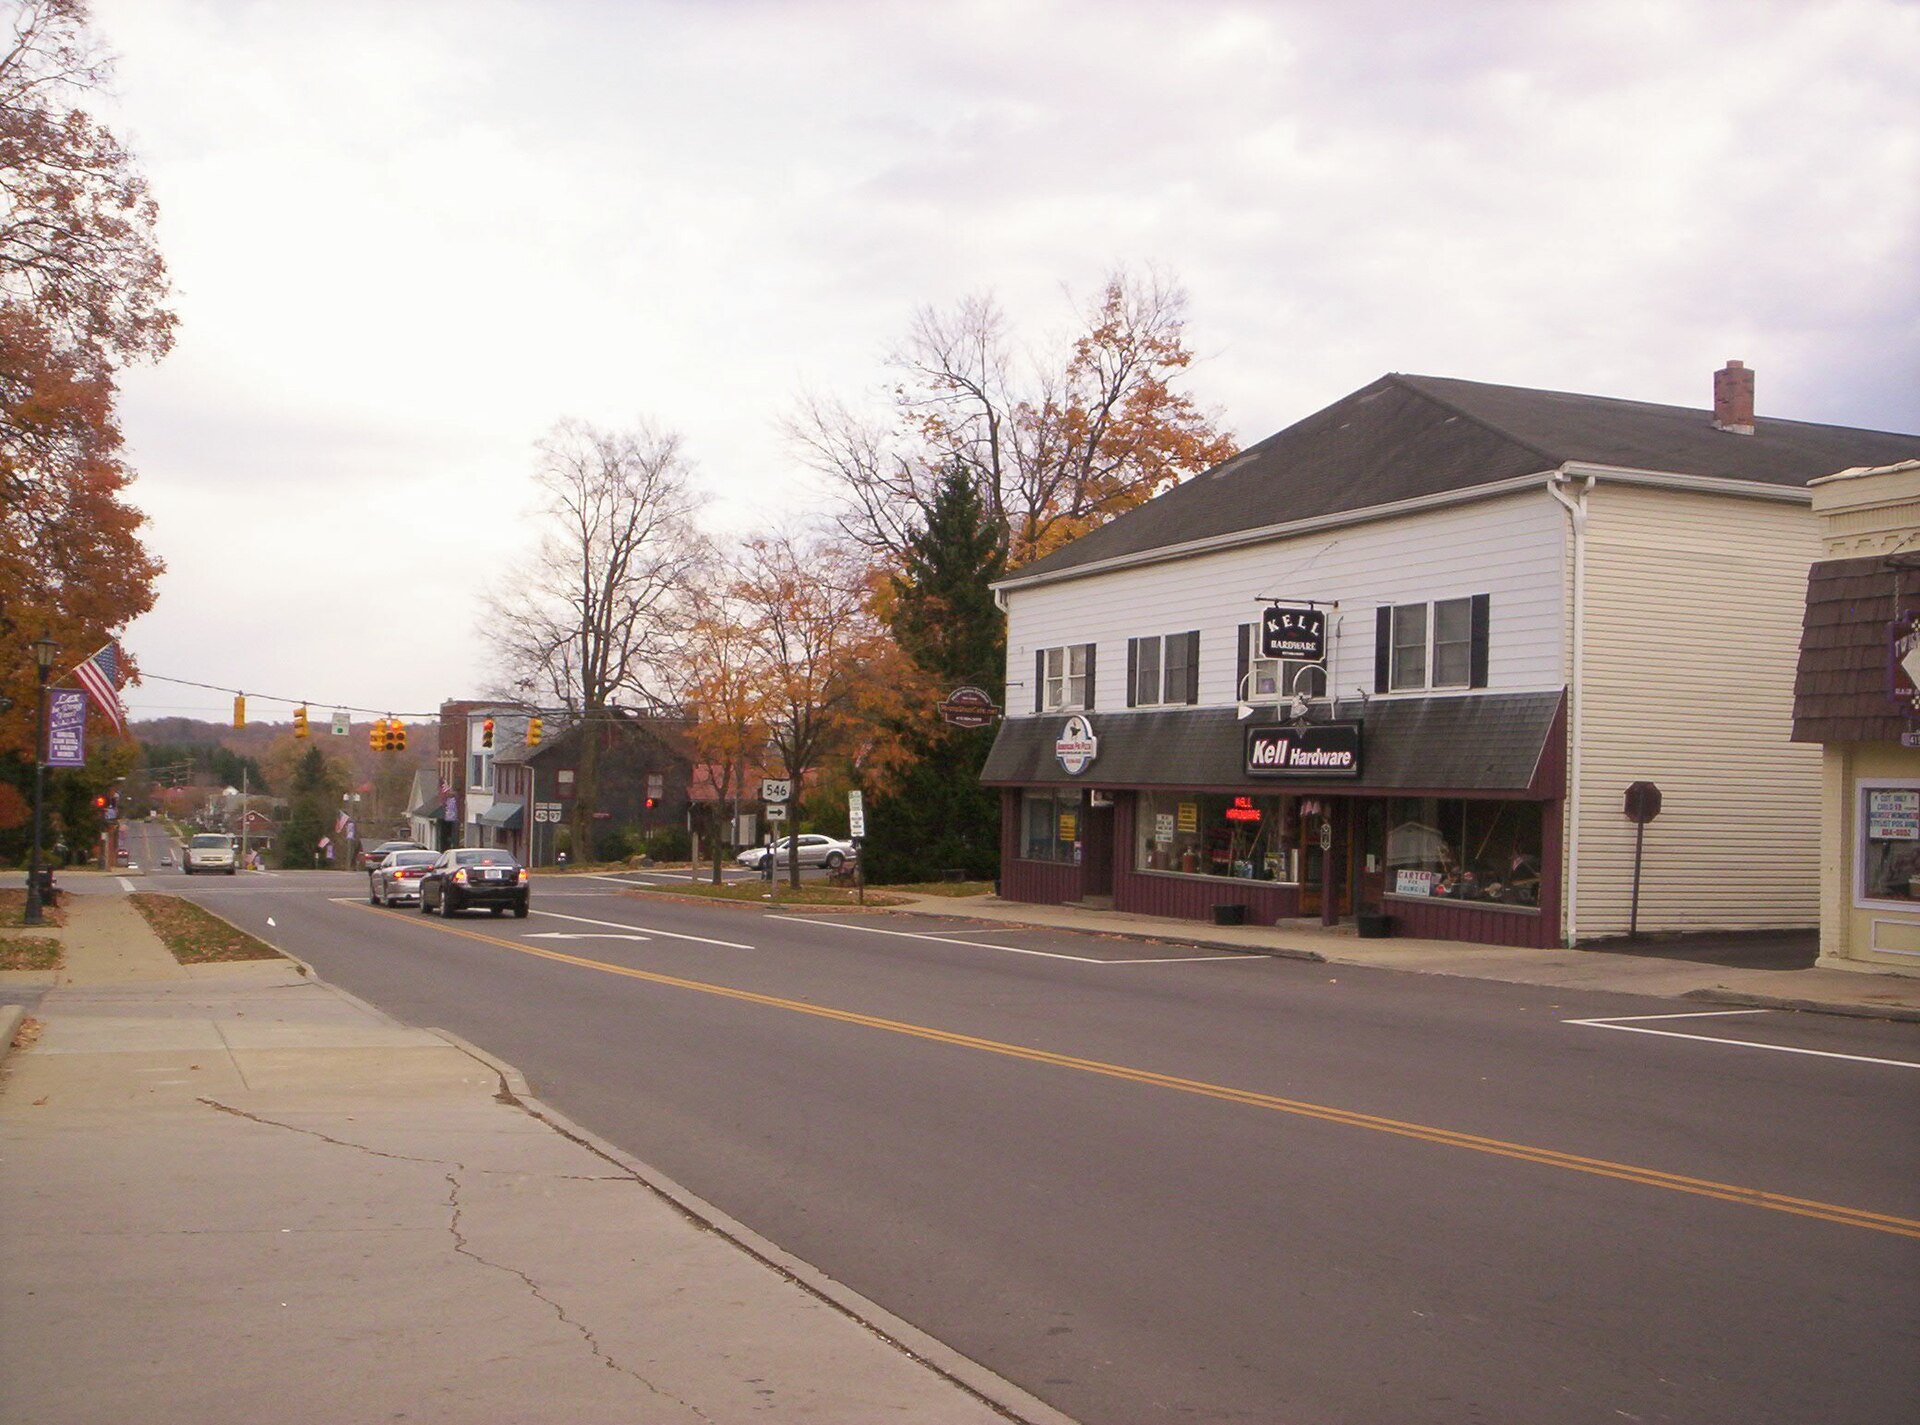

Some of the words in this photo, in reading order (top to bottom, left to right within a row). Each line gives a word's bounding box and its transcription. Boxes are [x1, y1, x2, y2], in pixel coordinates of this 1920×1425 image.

[1267, 614, 1319, 636] KELL
[1271, 640, 1317, 650] HARDWARE
[1252, 739, 1288, 764] Kell
[1289, 748, 1352, 766] Hardware
[767, 784, 787, 796] 546
